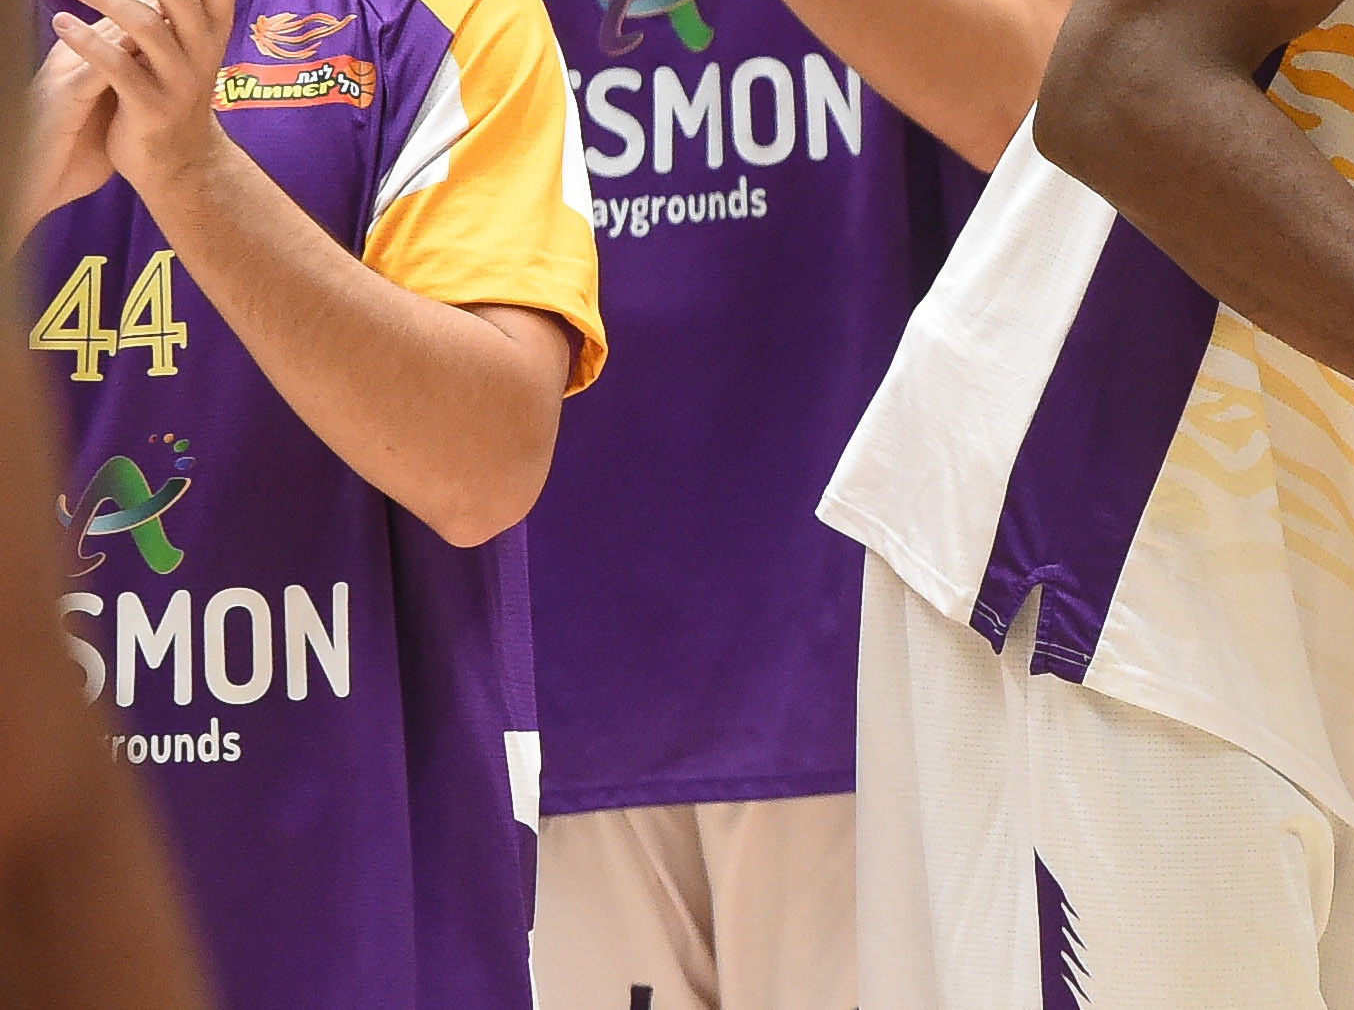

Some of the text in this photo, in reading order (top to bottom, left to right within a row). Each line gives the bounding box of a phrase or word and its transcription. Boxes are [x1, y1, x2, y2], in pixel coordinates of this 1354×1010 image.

[226, 77, 337, 102] Winner
[568, 53, 862, 178] SMON
[29, 250, 188, 382] 44
[105, 716, 242, 765] rounds
